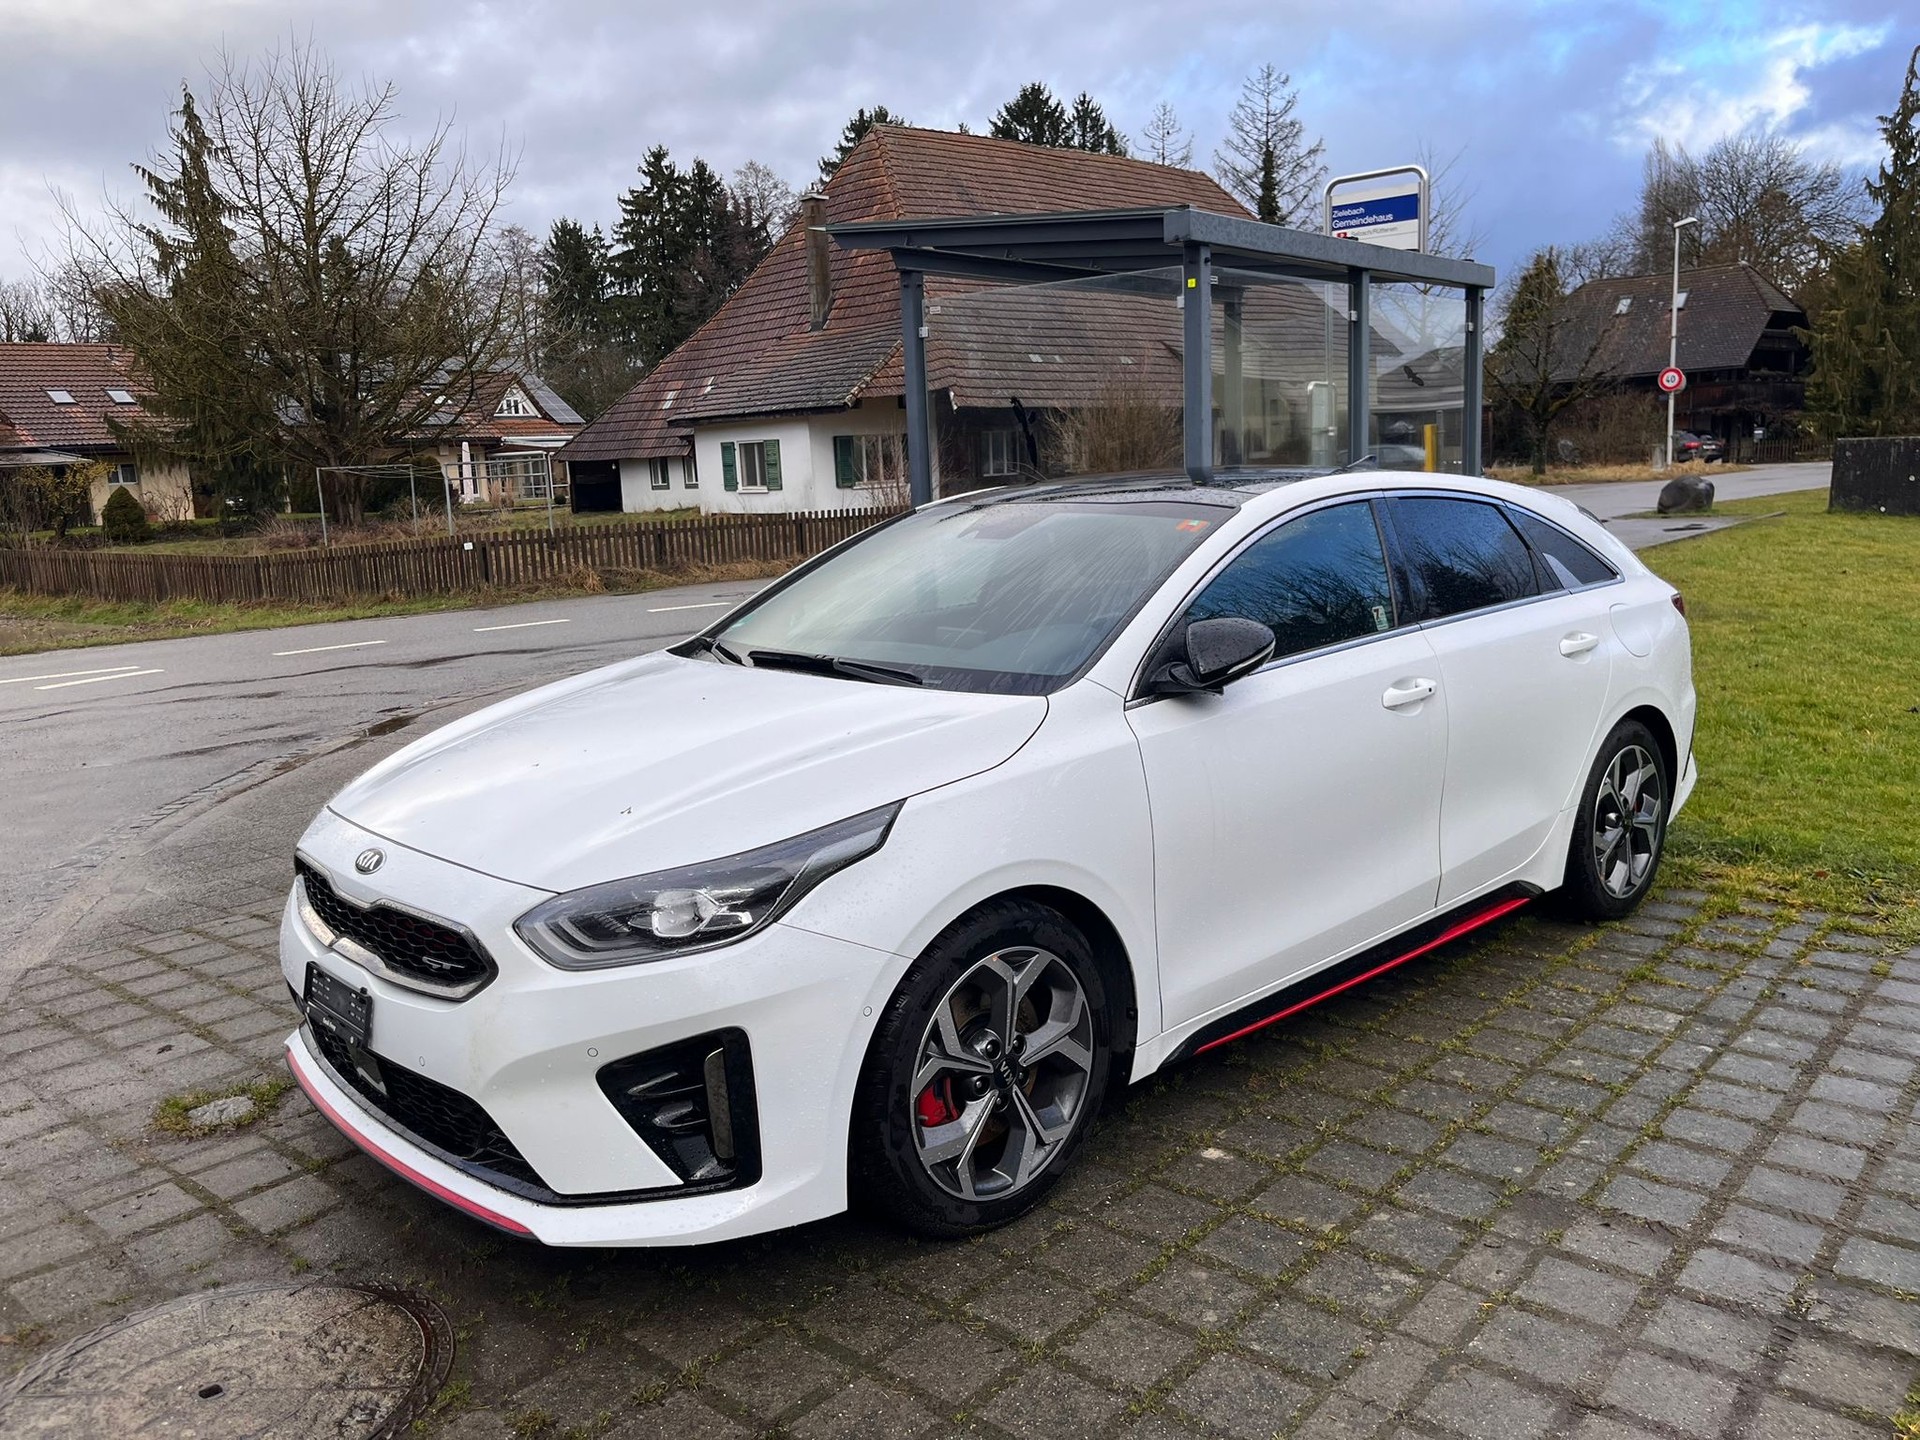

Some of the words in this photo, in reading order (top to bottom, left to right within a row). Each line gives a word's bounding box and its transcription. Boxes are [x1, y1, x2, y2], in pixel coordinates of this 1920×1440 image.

[1332, 206, 1365, 218] Zielebach
[1332, 213, 1394, 229] Gemeindehaus
[1666, 374, 1677, 384] 40
[356, 851, 380, 870] KIA
[422, 956, 465, 970] GT
[999, 1060, 1014, 1085] KIA
